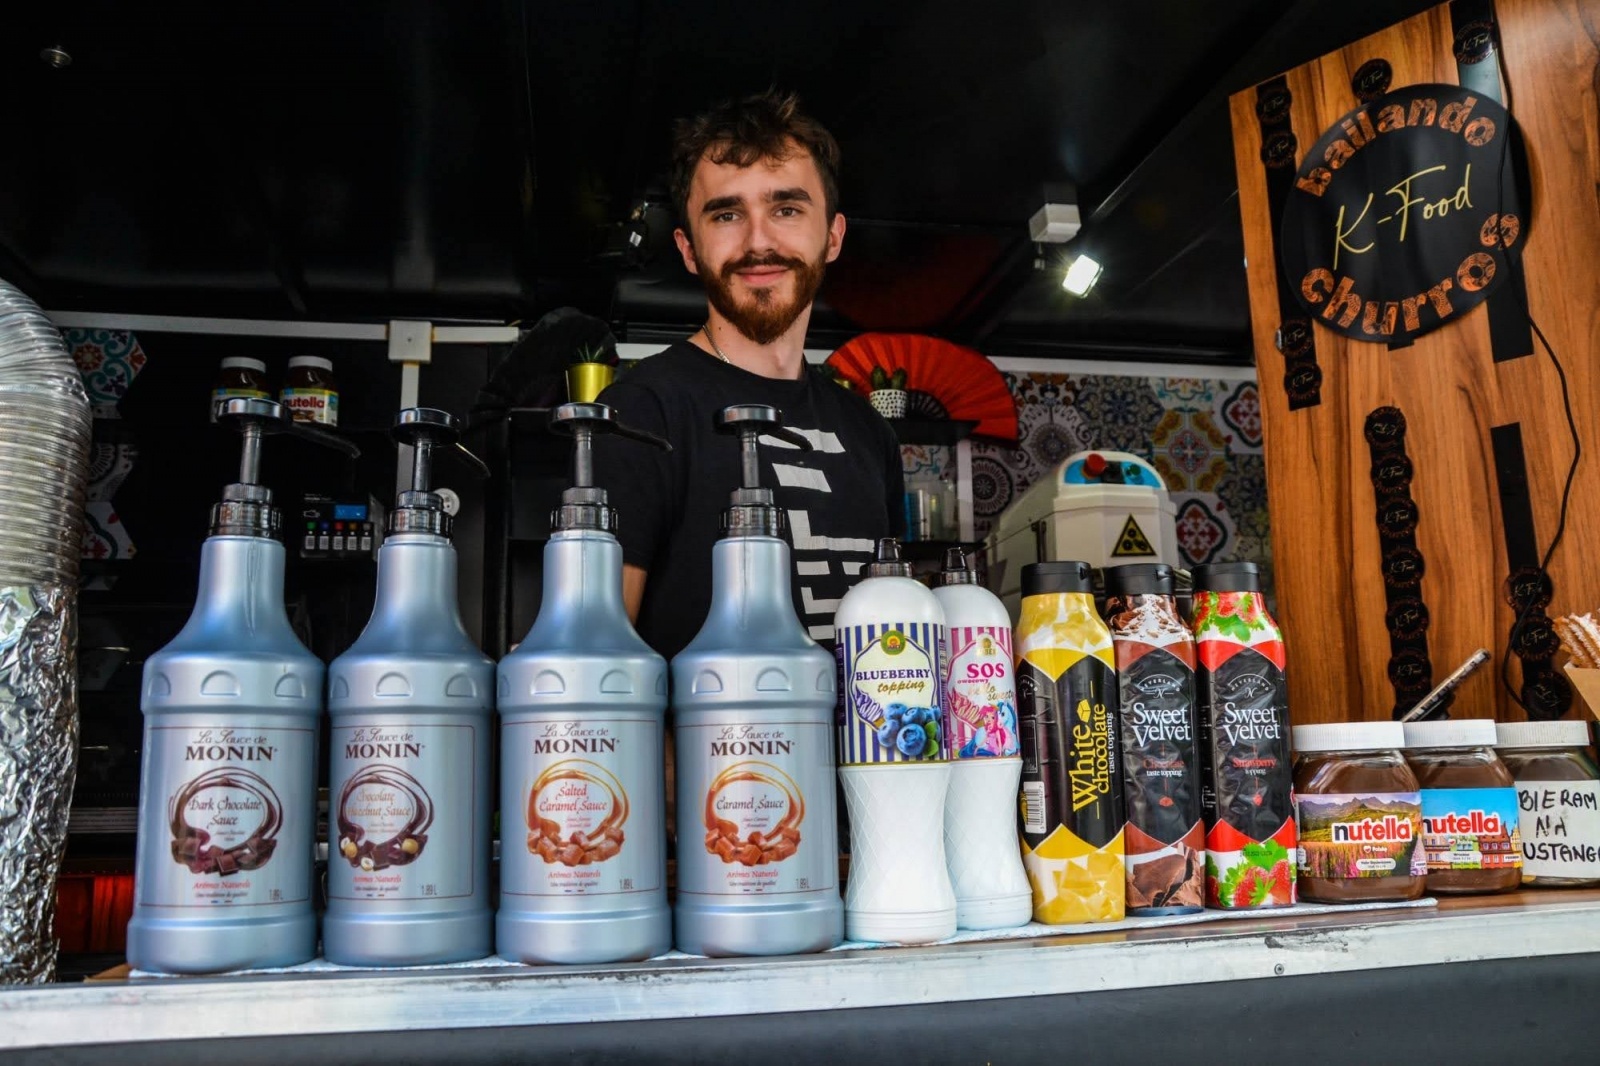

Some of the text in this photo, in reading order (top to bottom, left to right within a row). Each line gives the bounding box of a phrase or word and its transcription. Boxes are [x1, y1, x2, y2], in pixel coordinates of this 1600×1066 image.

[1296, 96, 1496, 197] bailando
[1334, 163, 1474, 271] K-Food
[856, 668, 931, 681] BLUEBERRY
[966, 663, 1005, 678] SOS
[877, 680, 925, 695] topping
[1133, 702, 1188, 724] Sweet
[1224, 702, 1278, 724] Sweet
[192, 728, 267, 744] La Sauce de
[350, 729, 365, 742] La
[366, 728, 398, 742] Sauce
[541, 722, 608, 737] La Sauce de
[716, 725, 784, 740] La Sauce de
[1131, 719, 1191, 748] Velvet
[1223, 719, 1280, 747] Velvet
[185, 746, 273, 761] MONIN
[345, 743, 422, 759] MONIN
[534, 738, 616, 754] MONIN
[711, 740, 791, 756] MONIN
[1092, 703, 1110, 794] chocolate
[1069, 725, 1098, 812] White
[556, 782, 588, 799] Salted
[188, 796, 262, 814] Dark Chocolate
[540, 796, 607, 814] Caramel Sauce
[716, 795, 784, 812] Caramel Sauce
[207, 813, 239, 829] Sauce
[1334, 817, 1411, 841] nutella
[1536, 815, 1567, 838] NA
[1523, 842, 1600, 863] USTANG
